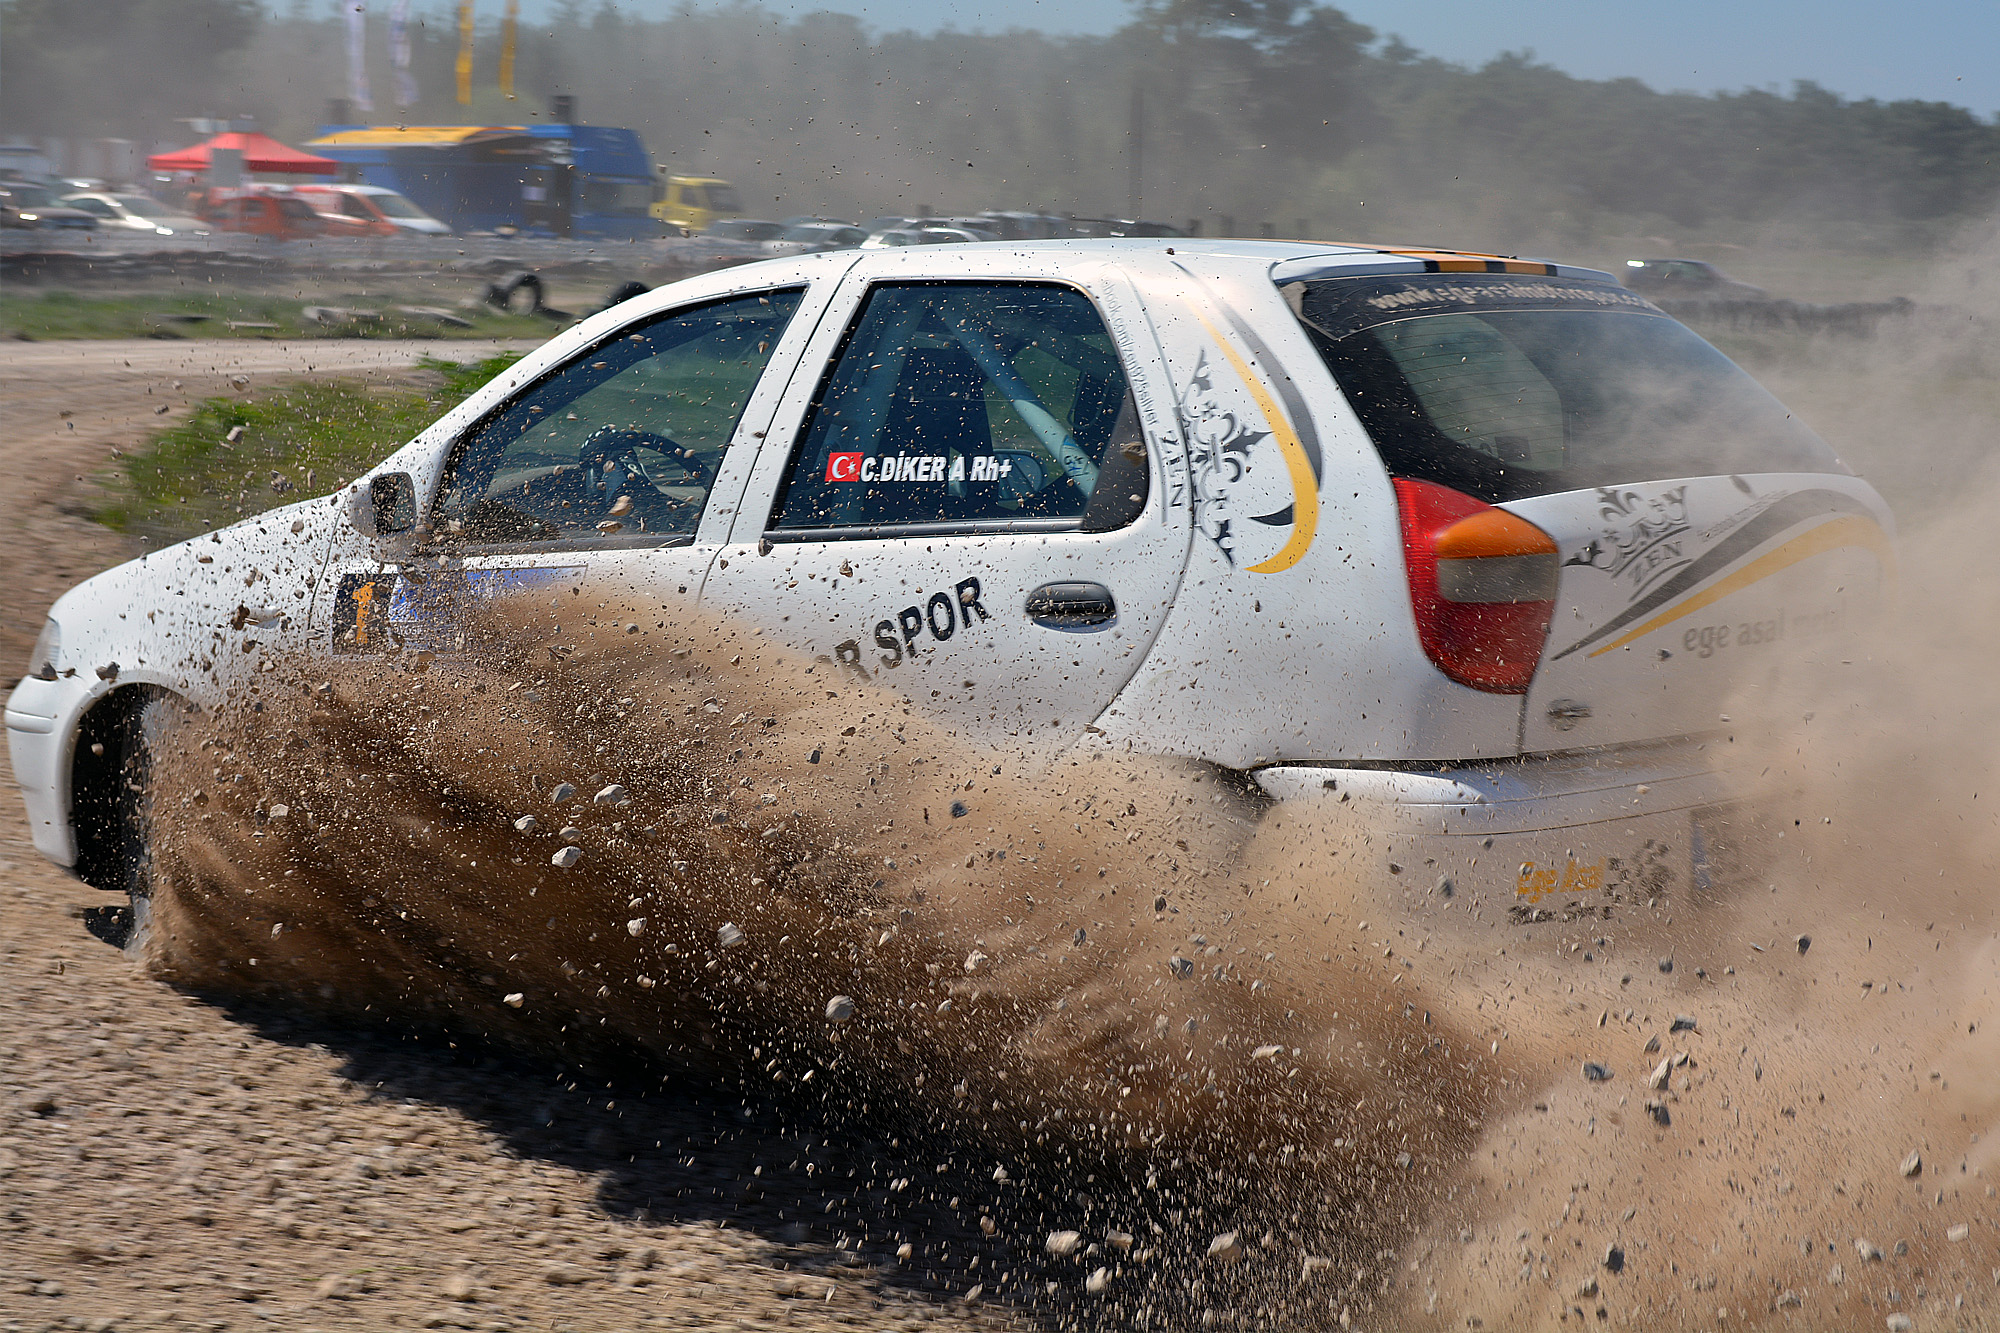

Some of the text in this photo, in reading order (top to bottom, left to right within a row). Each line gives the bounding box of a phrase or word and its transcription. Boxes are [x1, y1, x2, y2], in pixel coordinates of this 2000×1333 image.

[1100, 265, 1160, 426] febook.com/zen925silver
[860, 451, 1012, 482] C.DİKER A Rh+
[1160, 431, 1185, 507] ZEN
[1628, 540, 1683, 587] ZEN
[352, 581, 376, 644] 1
[874, 576, 992, 670] SPOR
[1684, 624, 1730, 659] ege
[1737, 606, 1784, 646] asal
